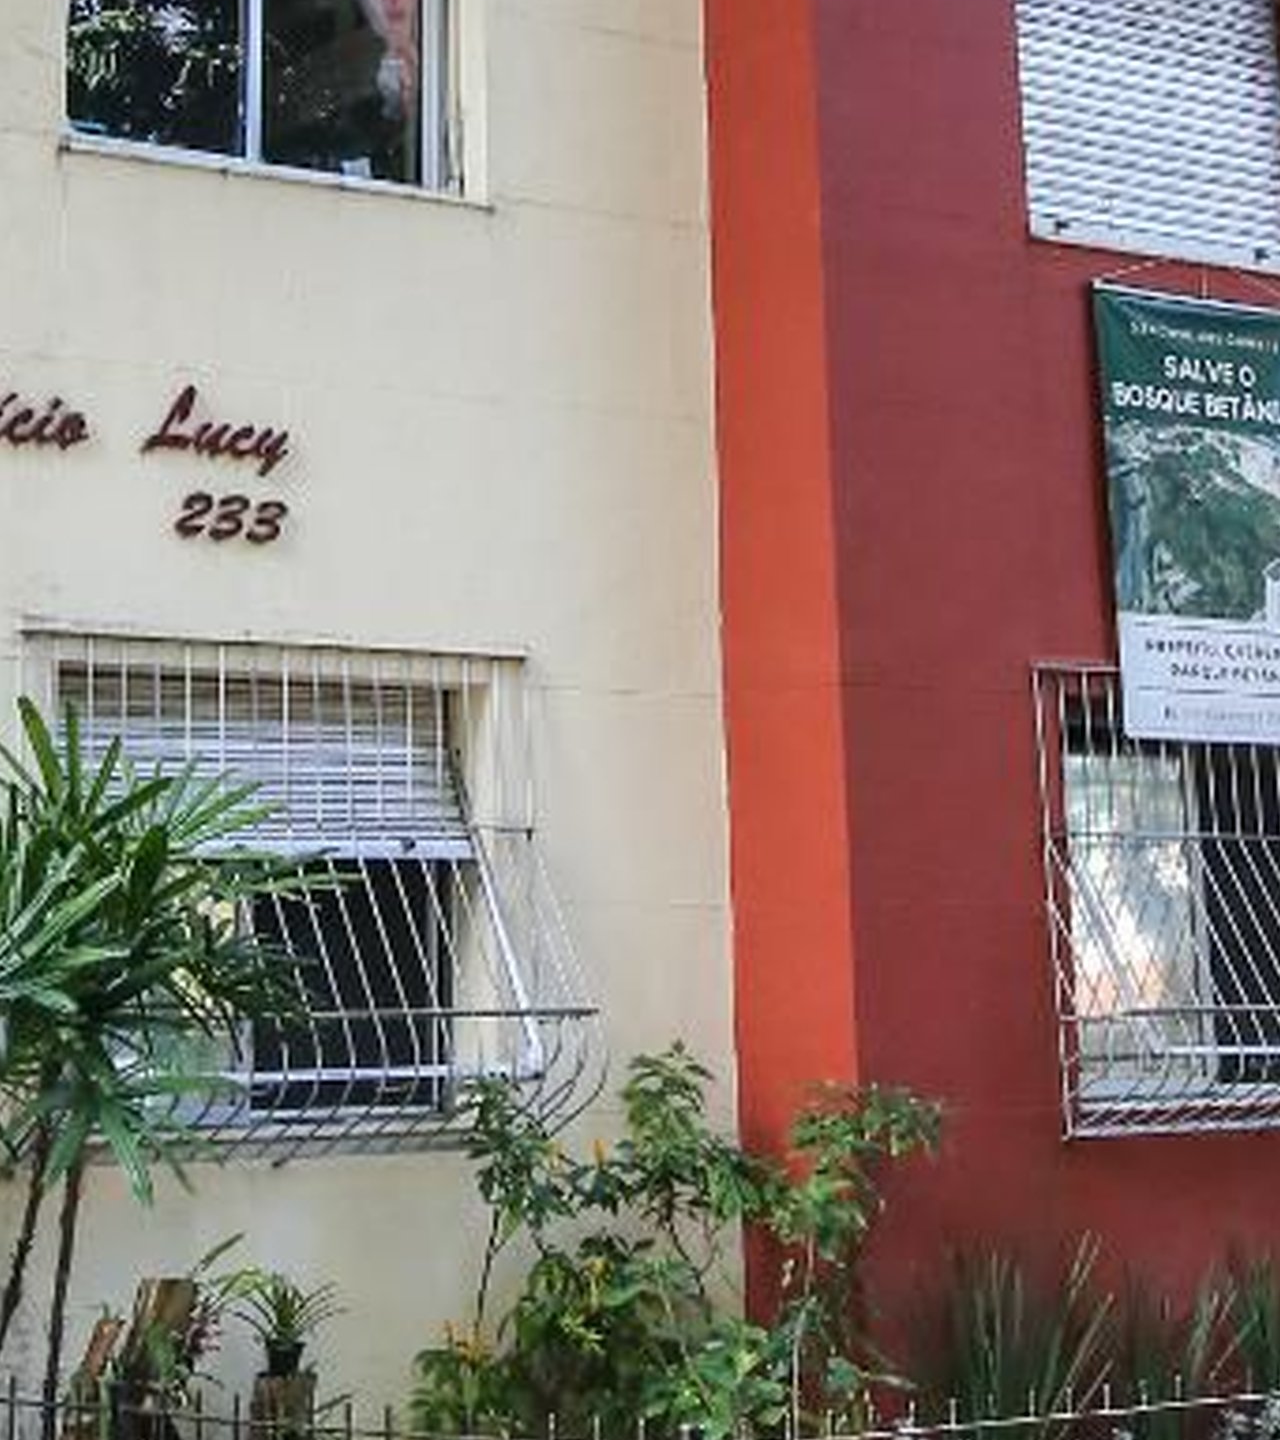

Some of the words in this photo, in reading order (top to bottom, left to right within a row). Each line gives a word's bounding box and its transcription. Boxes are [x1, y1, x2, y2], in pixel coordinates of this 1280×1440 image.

[1164, 355, 1234, 386] SALVE
[1238, 364, 1256, 388] O
[1111, 381, 1200, 415] BOSQUE
[140, 385, 288, 476] Lucy
[173, 491, 288, 545] 233
